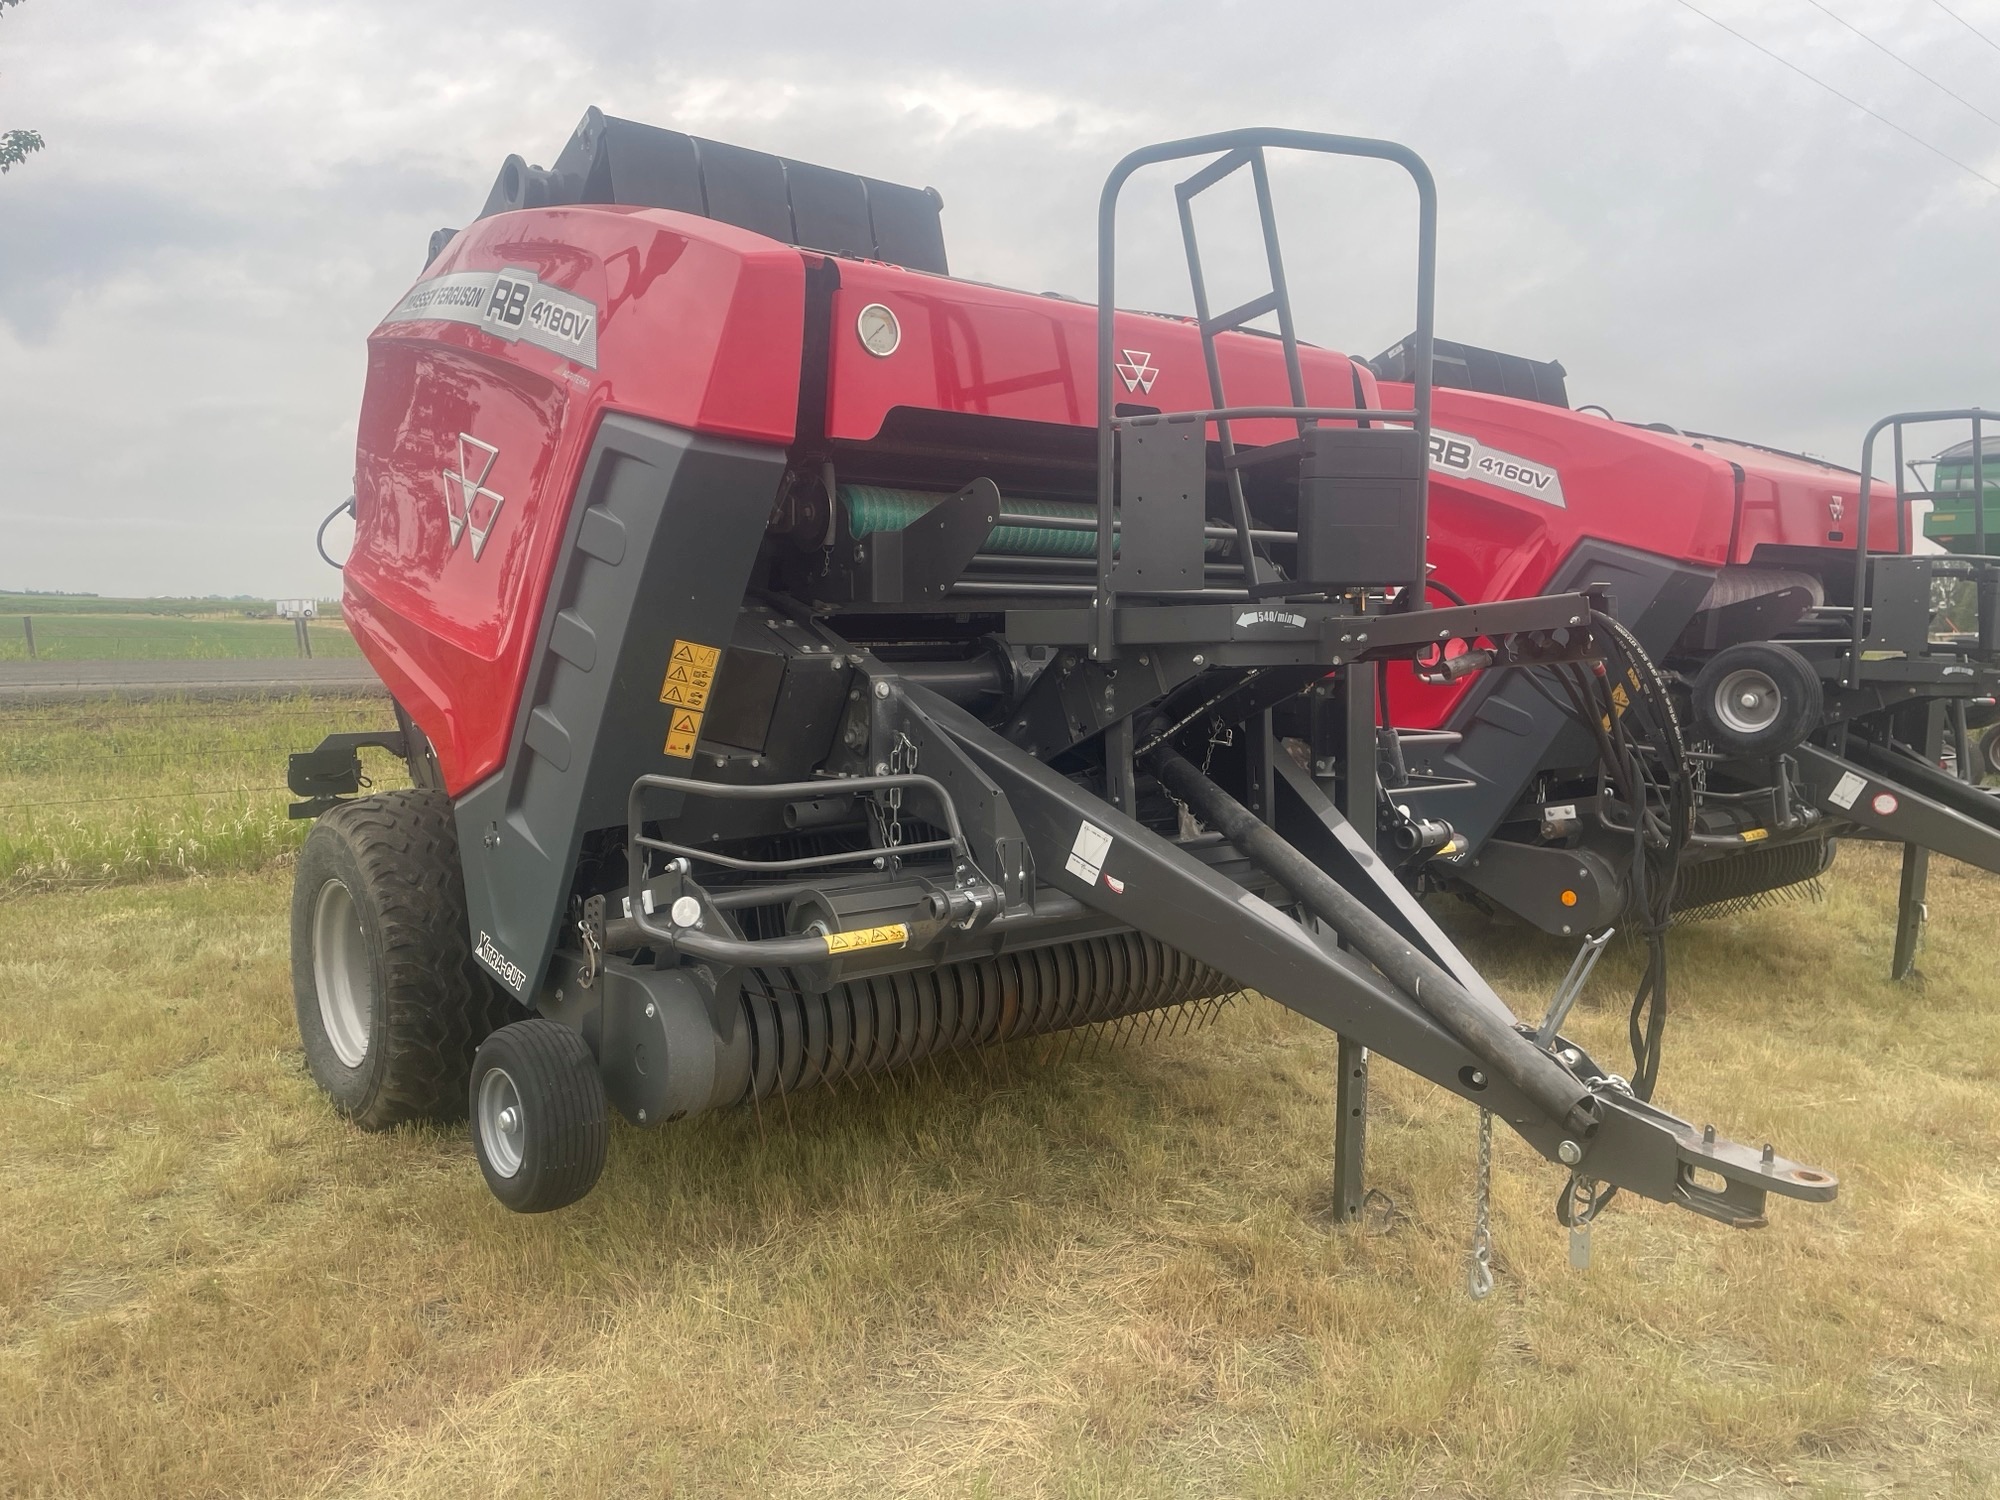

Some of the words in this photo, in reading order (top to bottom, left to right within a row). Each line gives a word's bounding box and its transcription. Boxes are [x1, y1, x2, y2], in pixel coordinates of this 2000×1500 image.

[434, 286, 485, 307] FERGUSON
[486, 279, 531, 326] RB
[530, 301, 590, 341] 4180V
[1429, 435, 1471, 470] RB
[1479, 457, 1551, 489] 4160V
[1258, 610, 1294, 624] 540/min
[475, 930, 526, 991] XTRA-CUT
